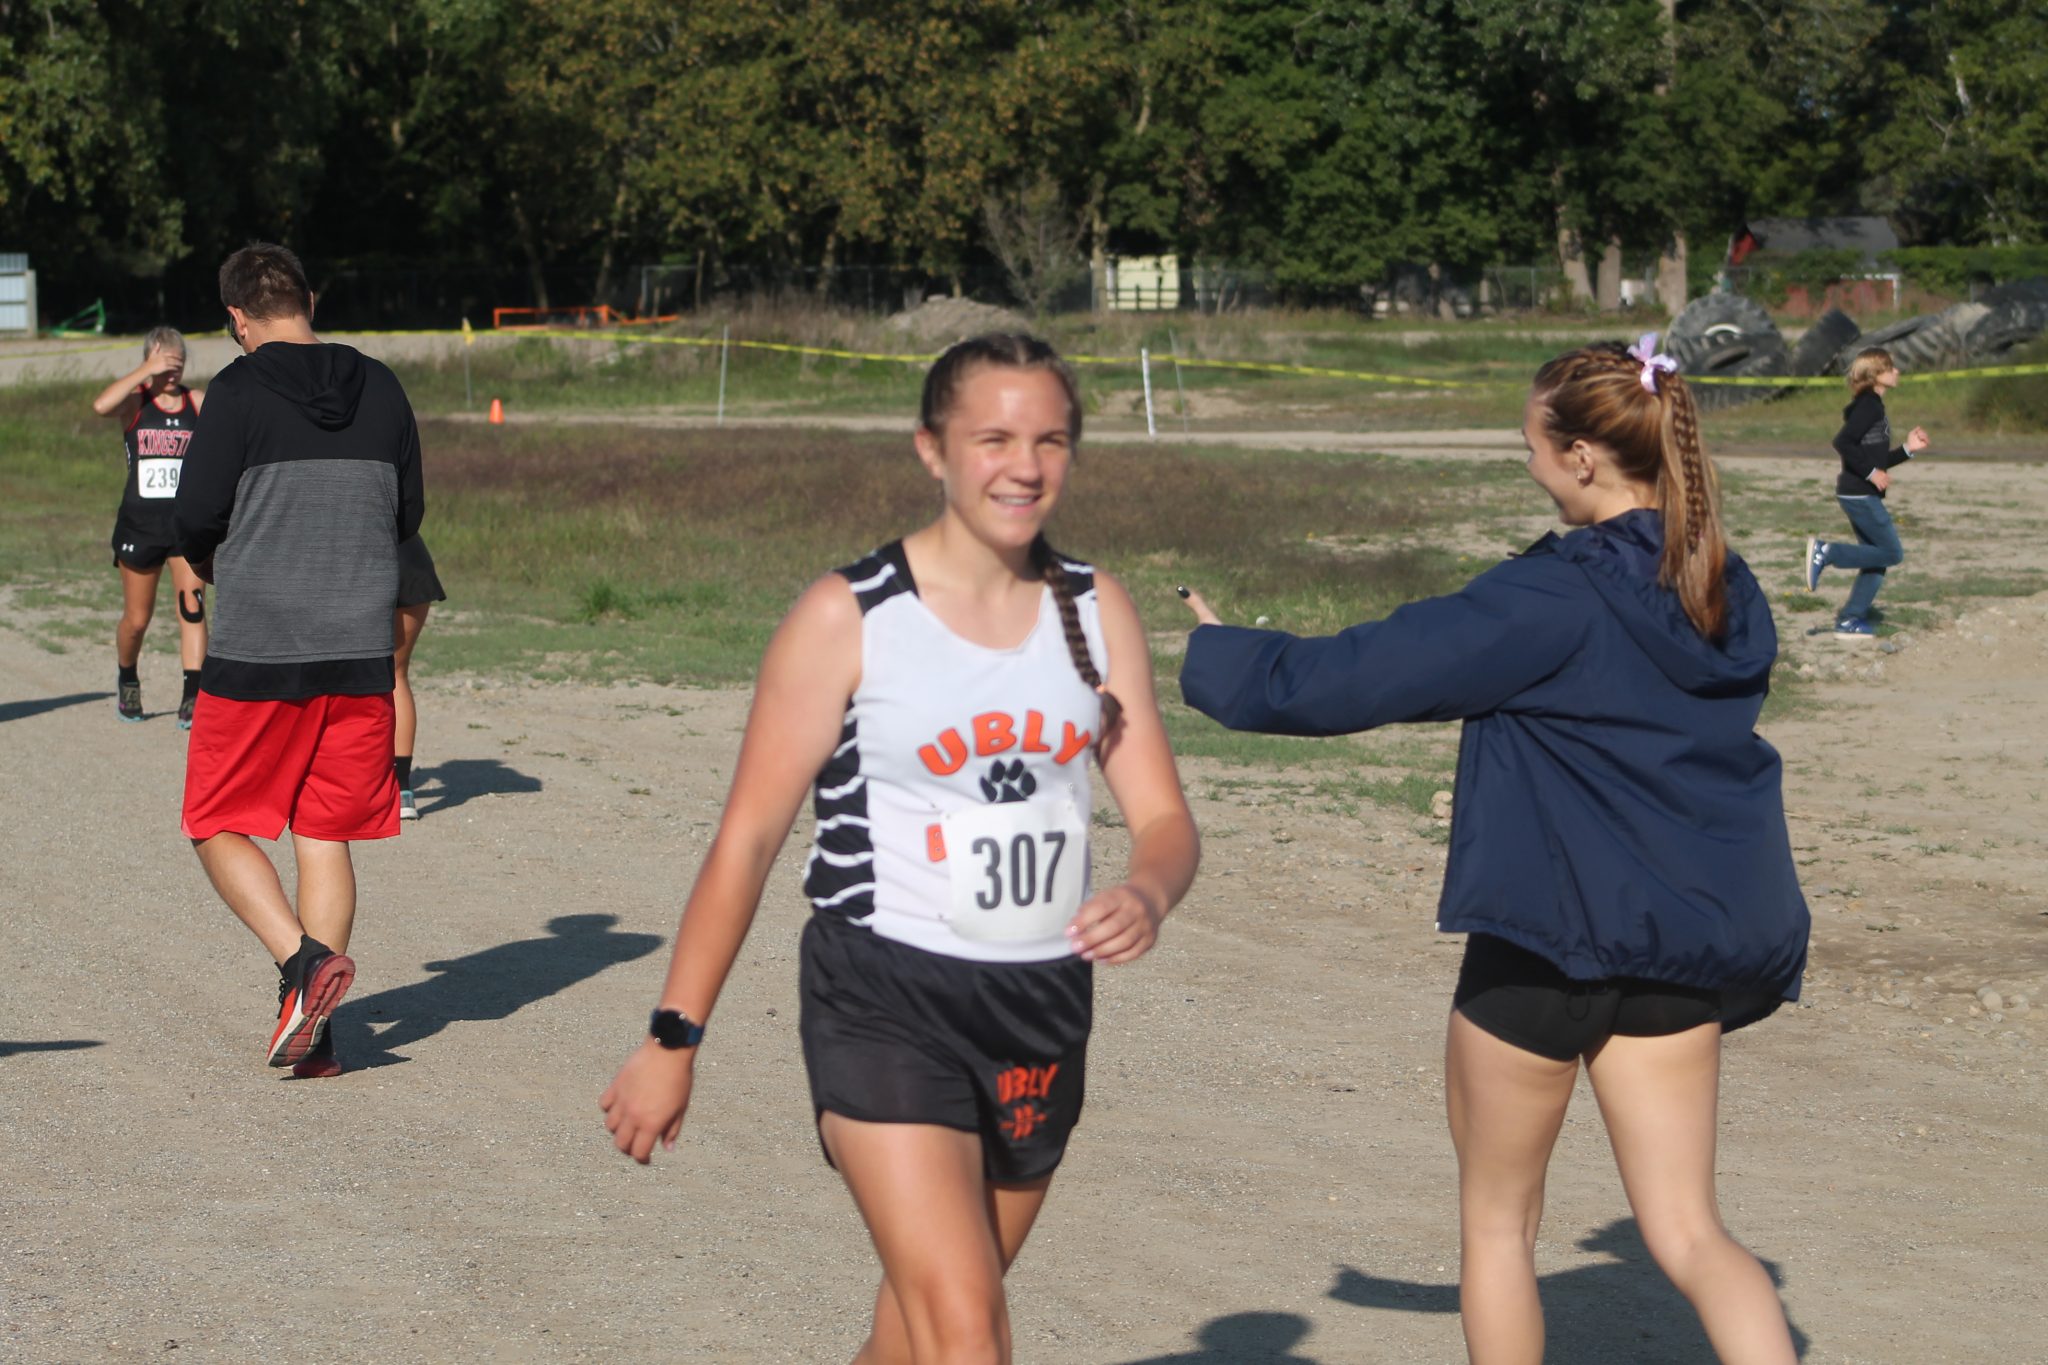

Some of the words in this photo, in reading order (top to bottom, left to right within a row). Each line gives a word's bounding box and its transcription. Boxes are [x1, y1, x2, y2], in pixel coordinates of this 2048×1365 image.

[137, 428, 193, 456] KINGST
[146, 467, 179, 489] 239
[917, 709, 1091, 776] UBLY
[971, 831, 1067, 910] 307
[996, 1063, 1058, 1104] UBLY
